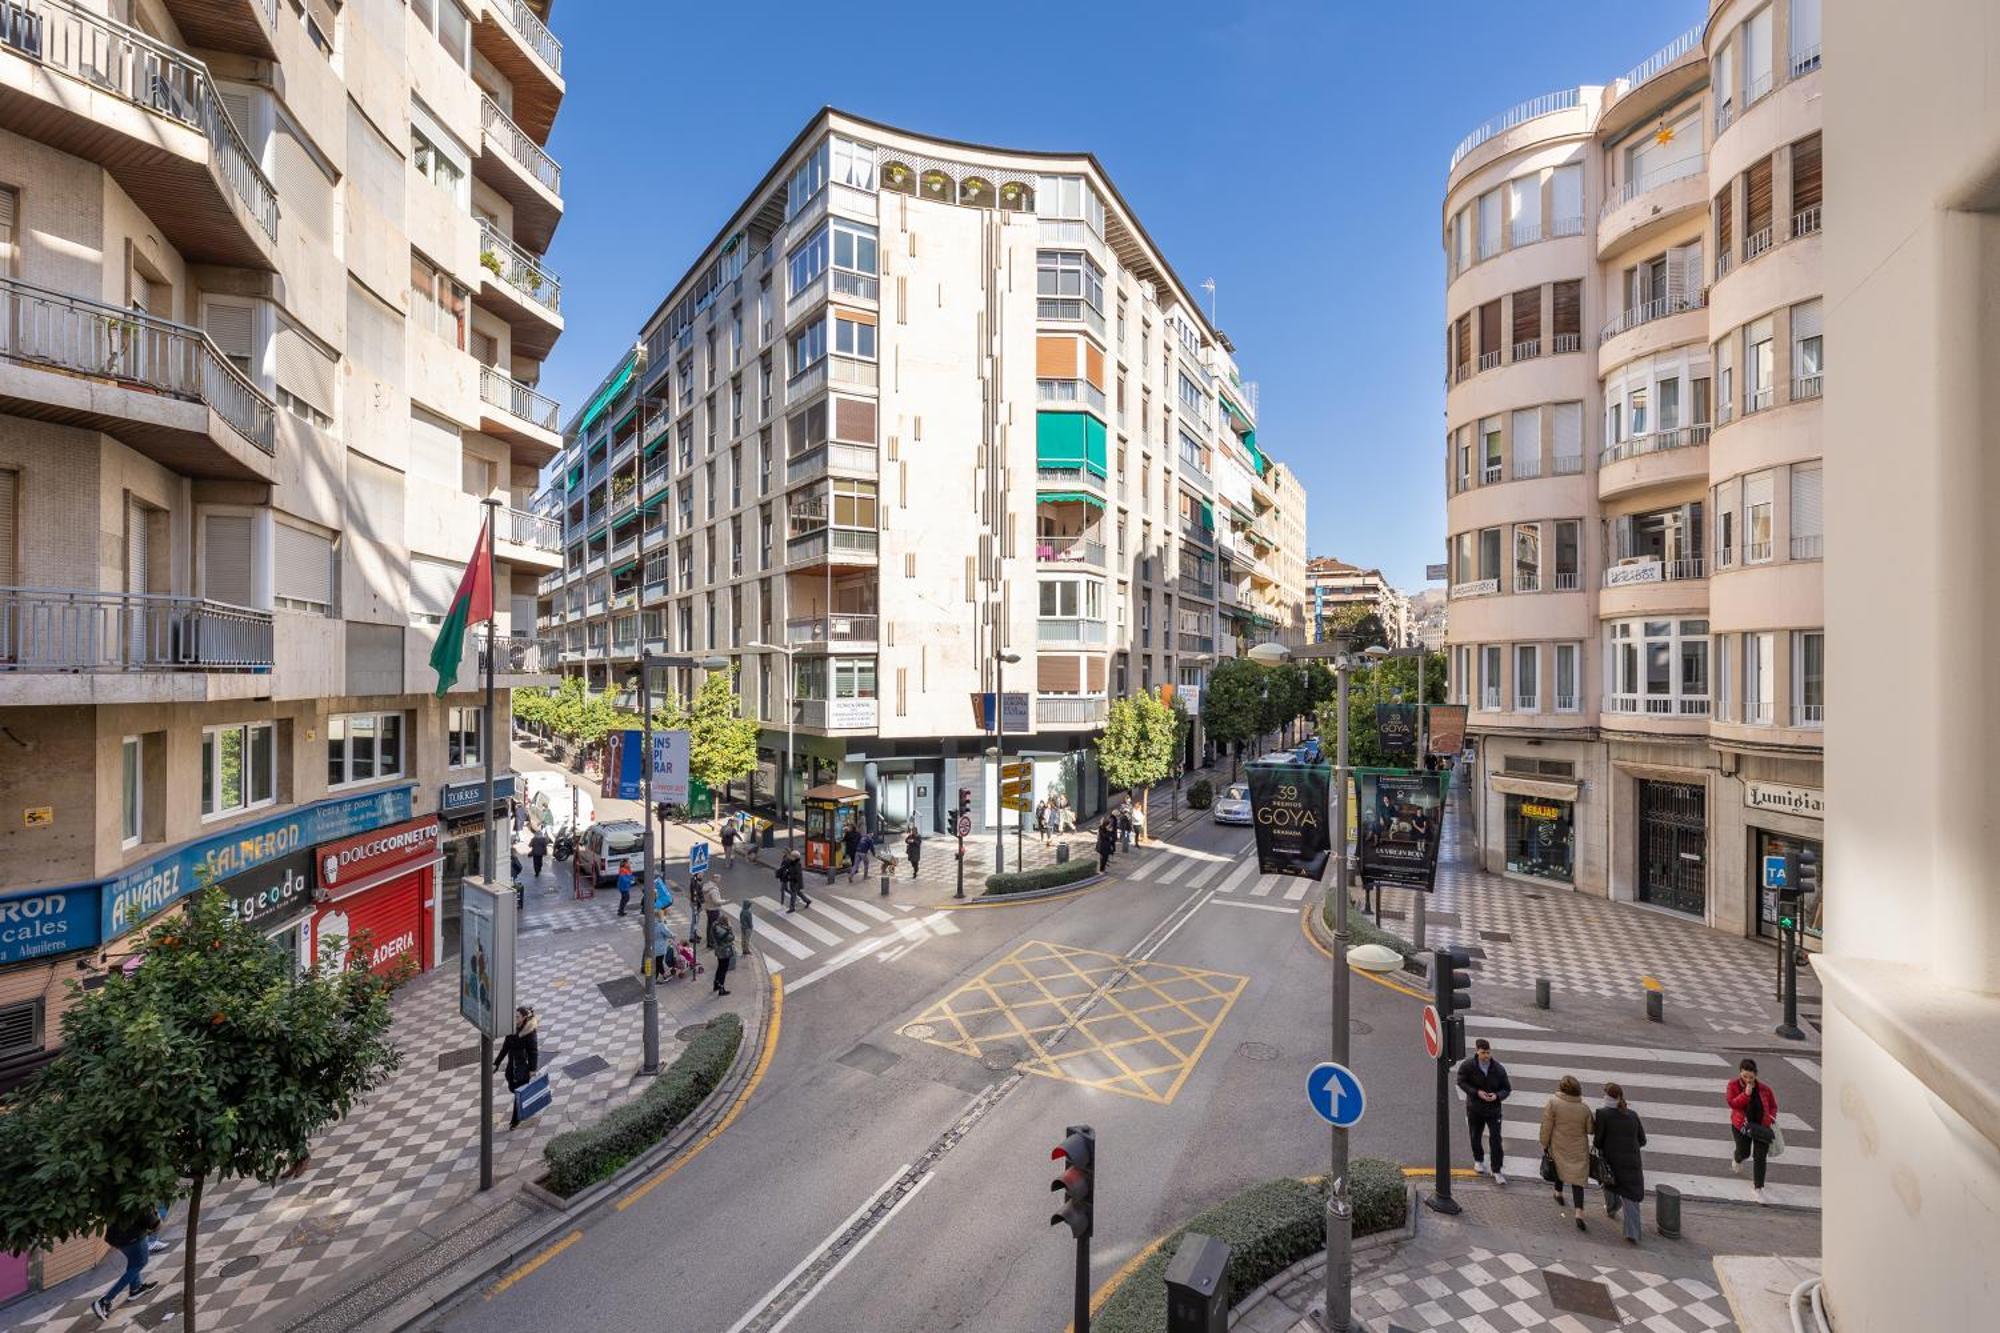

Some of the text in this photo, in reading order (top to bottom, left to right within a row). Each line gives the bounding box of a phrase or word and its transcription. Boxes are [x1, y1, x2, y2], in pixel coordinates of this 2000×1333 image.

[1381, 724, 1409, 733] GOYA
[654, 738, 671, 749] INS
[654, 750, 663, 760] PI
[654, 762, 673, 774] RAR
[447, 789, 480, 804] TORRES
[1277, 785, 1298, 801] 39
[1750, 788, 1824, 814] Lumigia
[1257, 807, 1317, 828] GOYA
[112, 865, 180, 932] ALVAREZ
[244, 868, 305, 922] geoda
